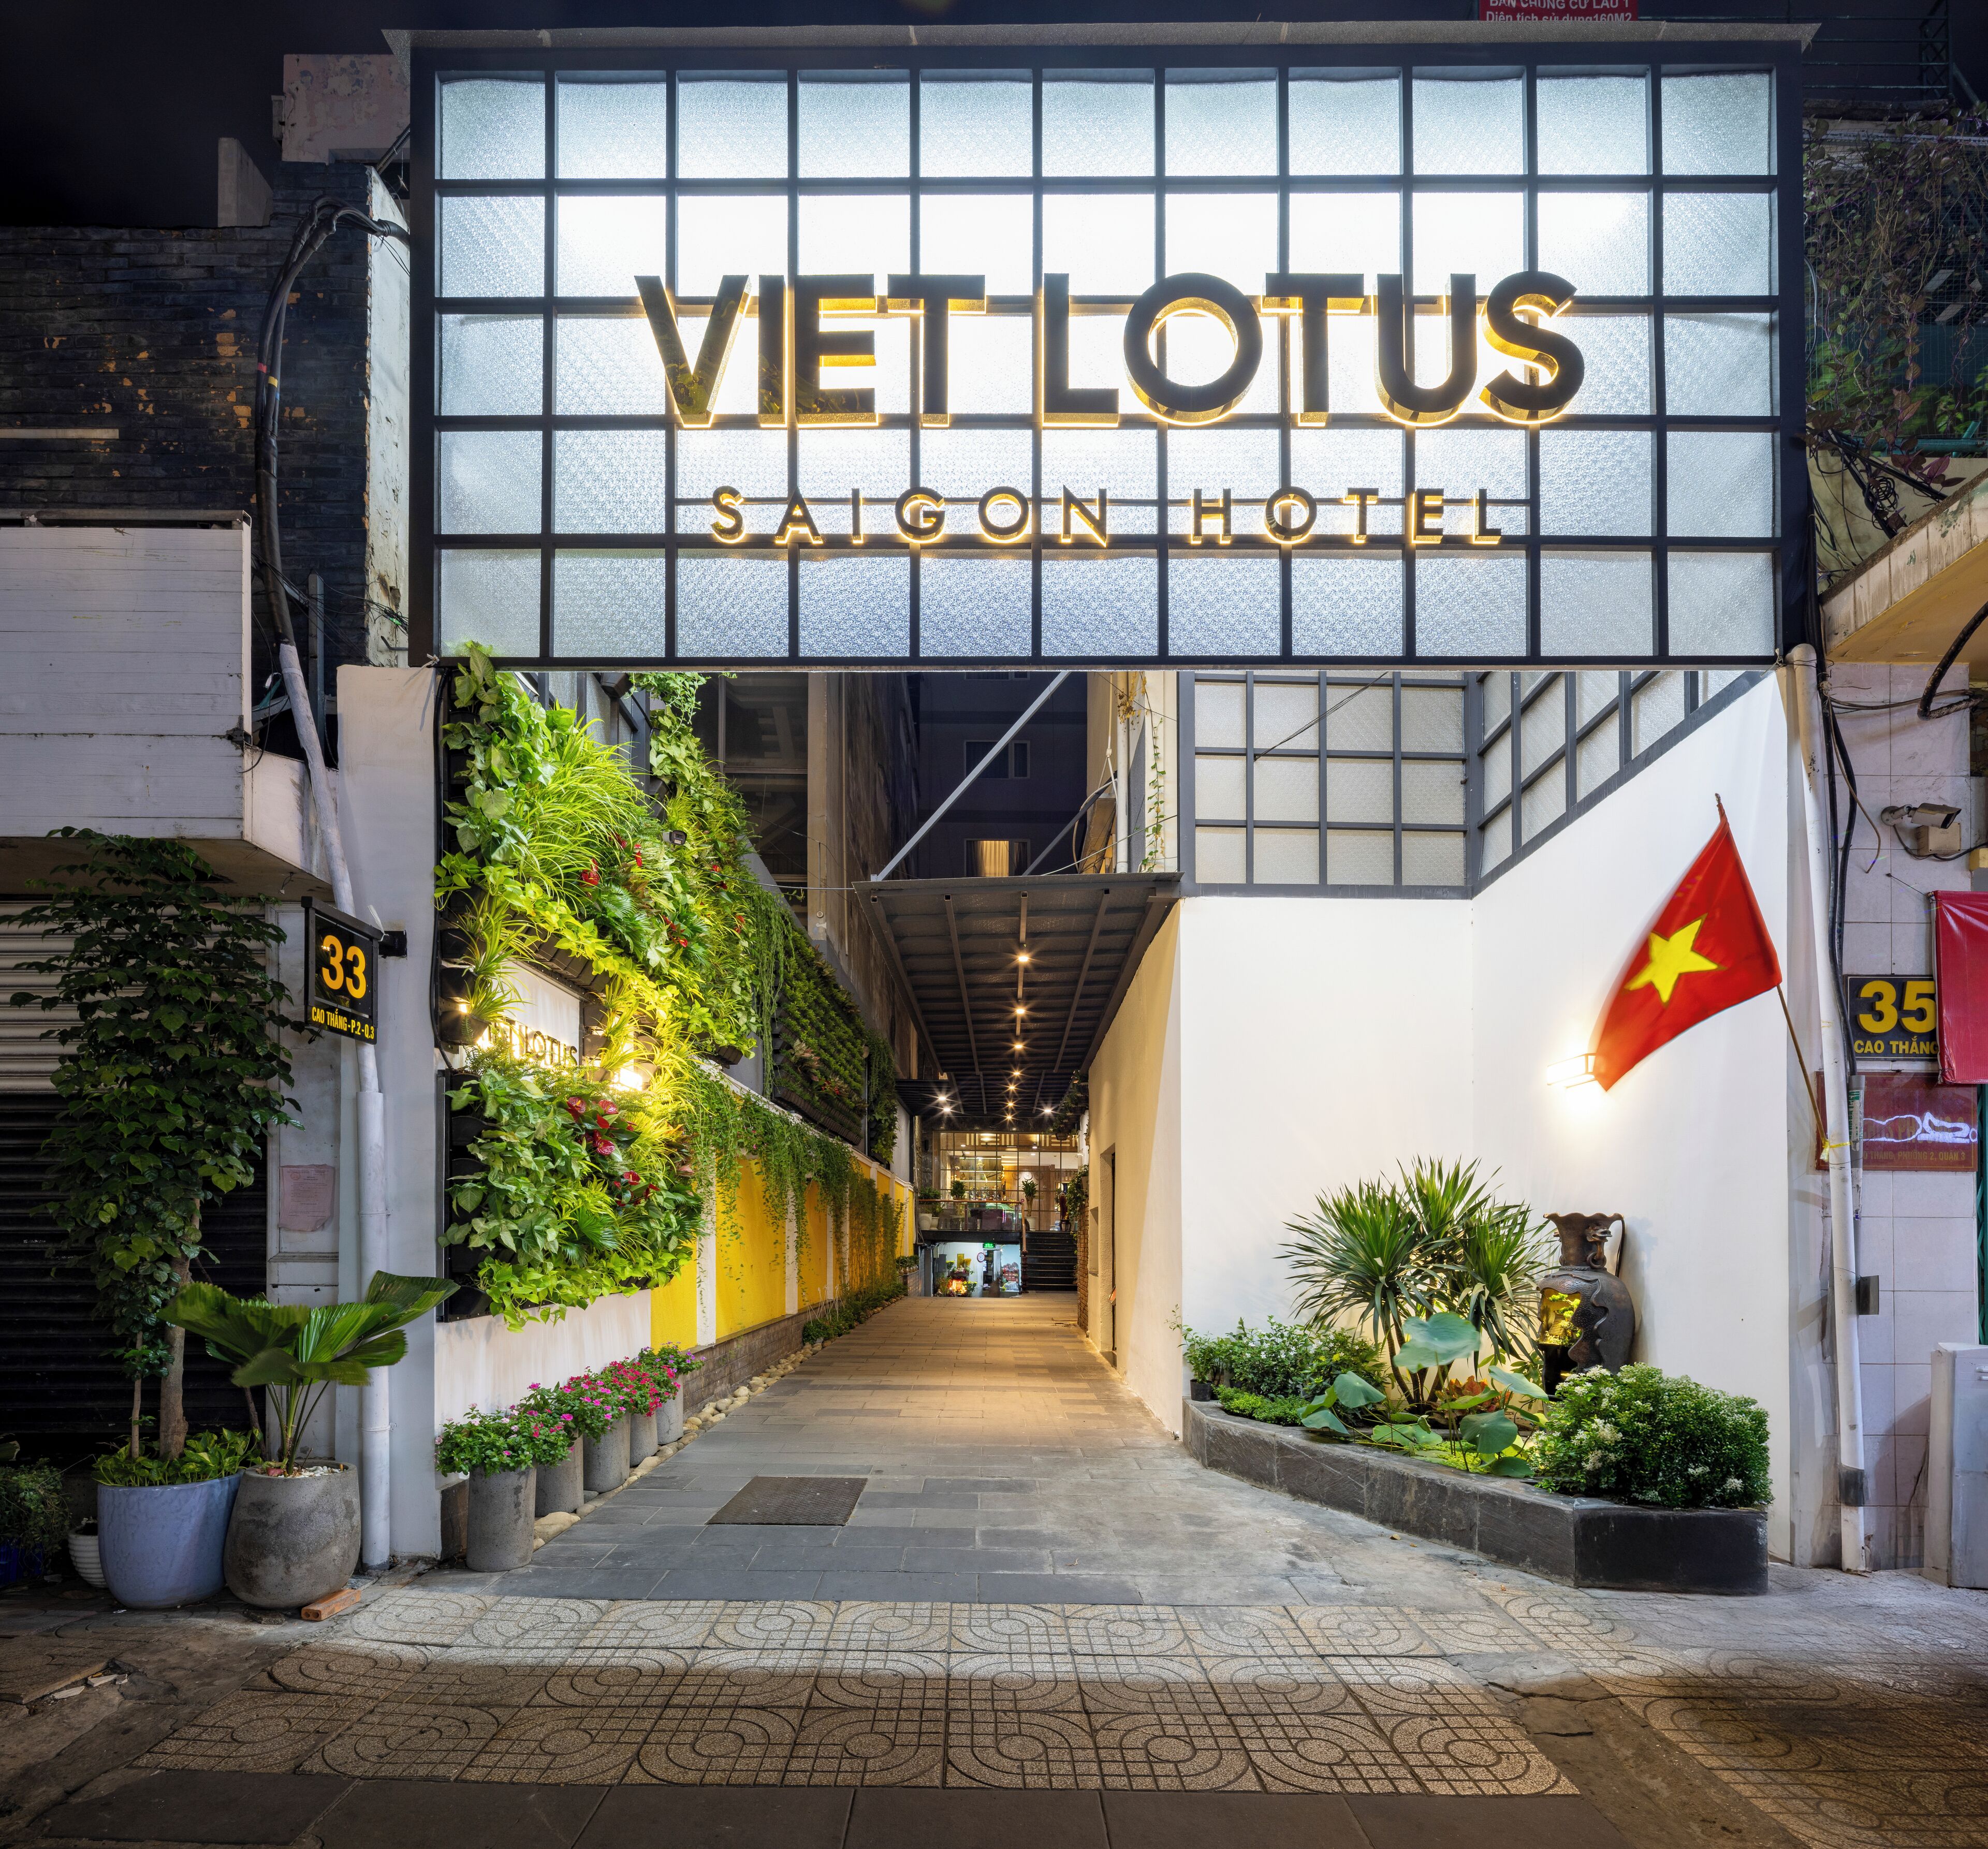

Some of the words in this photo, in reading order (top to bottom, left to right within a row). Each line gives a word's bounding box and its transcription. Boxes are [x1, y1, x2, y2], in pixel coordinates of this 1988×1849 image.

[1516, 12, 1539, 21] tích
[1520, 0, 1566, 9] CHUNG
[634, 274, 986, 428] VIET
[1043, 271, 1585, 427] LOTUS
[711, 485, 1107, 546] SAIGON
[1191, 486, 1502, 545] HOTEL
[321, 935, 367, 999] 33
[312, 1006, 325, 1024] CAO
[1857, 980, 1937, 1034] 35
[1853, 1039, 1884, 1054] CAO
[1889, 1035, 1939, 1054] THẮNG
